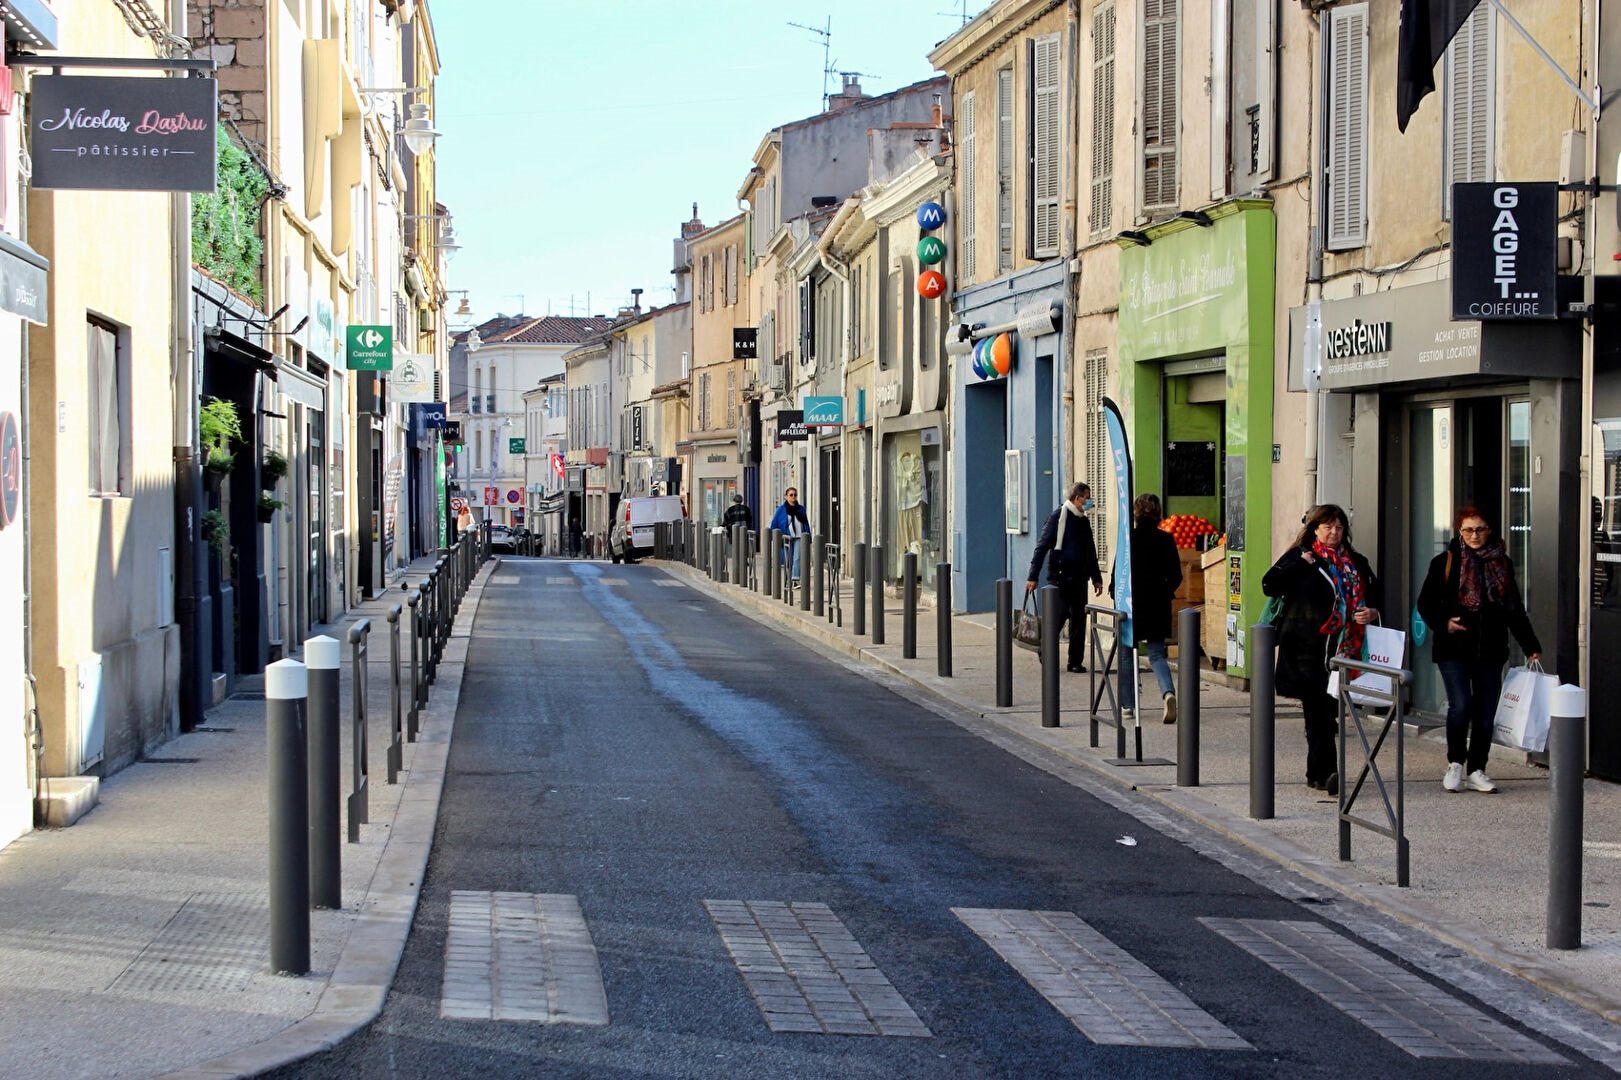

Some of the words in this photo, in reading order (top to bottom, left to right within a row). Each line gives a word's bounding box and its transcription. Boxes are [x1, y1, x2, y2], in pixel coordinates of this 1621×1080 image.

[40, 107, 130, 132] Nicolas
[78, 144, 169, 157] pâtissier
[1469, 302, 1540, 316] COIFFURE
[1434, 330, 1455, 343] ACHAT
[1458, 326, 1478, 341] VENTE
[352, 350, 388, 358] Carrefour
[1418, 350, 1444, 363] GESTION
[1446, 345, 1478, 360] LOCATION
[363, 358, 377, 366] city
[807, 413, 840, 422] MAAF
[779, 428, 808, 436] AFFLELOU
